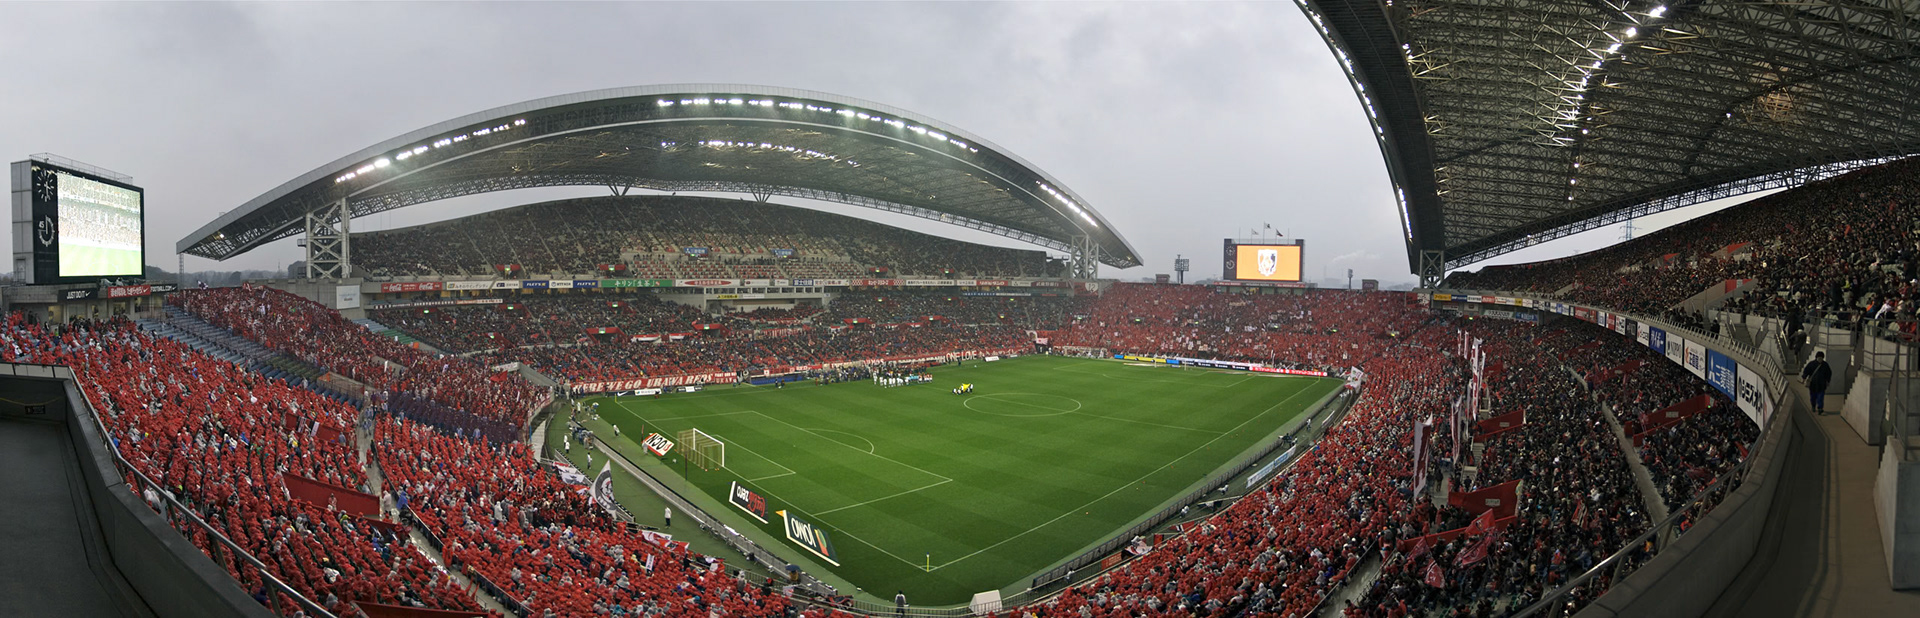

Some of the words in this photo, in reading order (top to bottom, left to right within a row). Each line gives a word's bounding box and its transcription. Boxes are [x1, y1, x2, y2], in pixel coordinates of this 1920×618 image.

[961, 350, 977, 362] LOVE
[625, 378, 642, 390] GO
[646, 375, 684, 389] URAWA
[685, 373, 713, 385] REDS
[790, 517, 817, 548] JOMO
